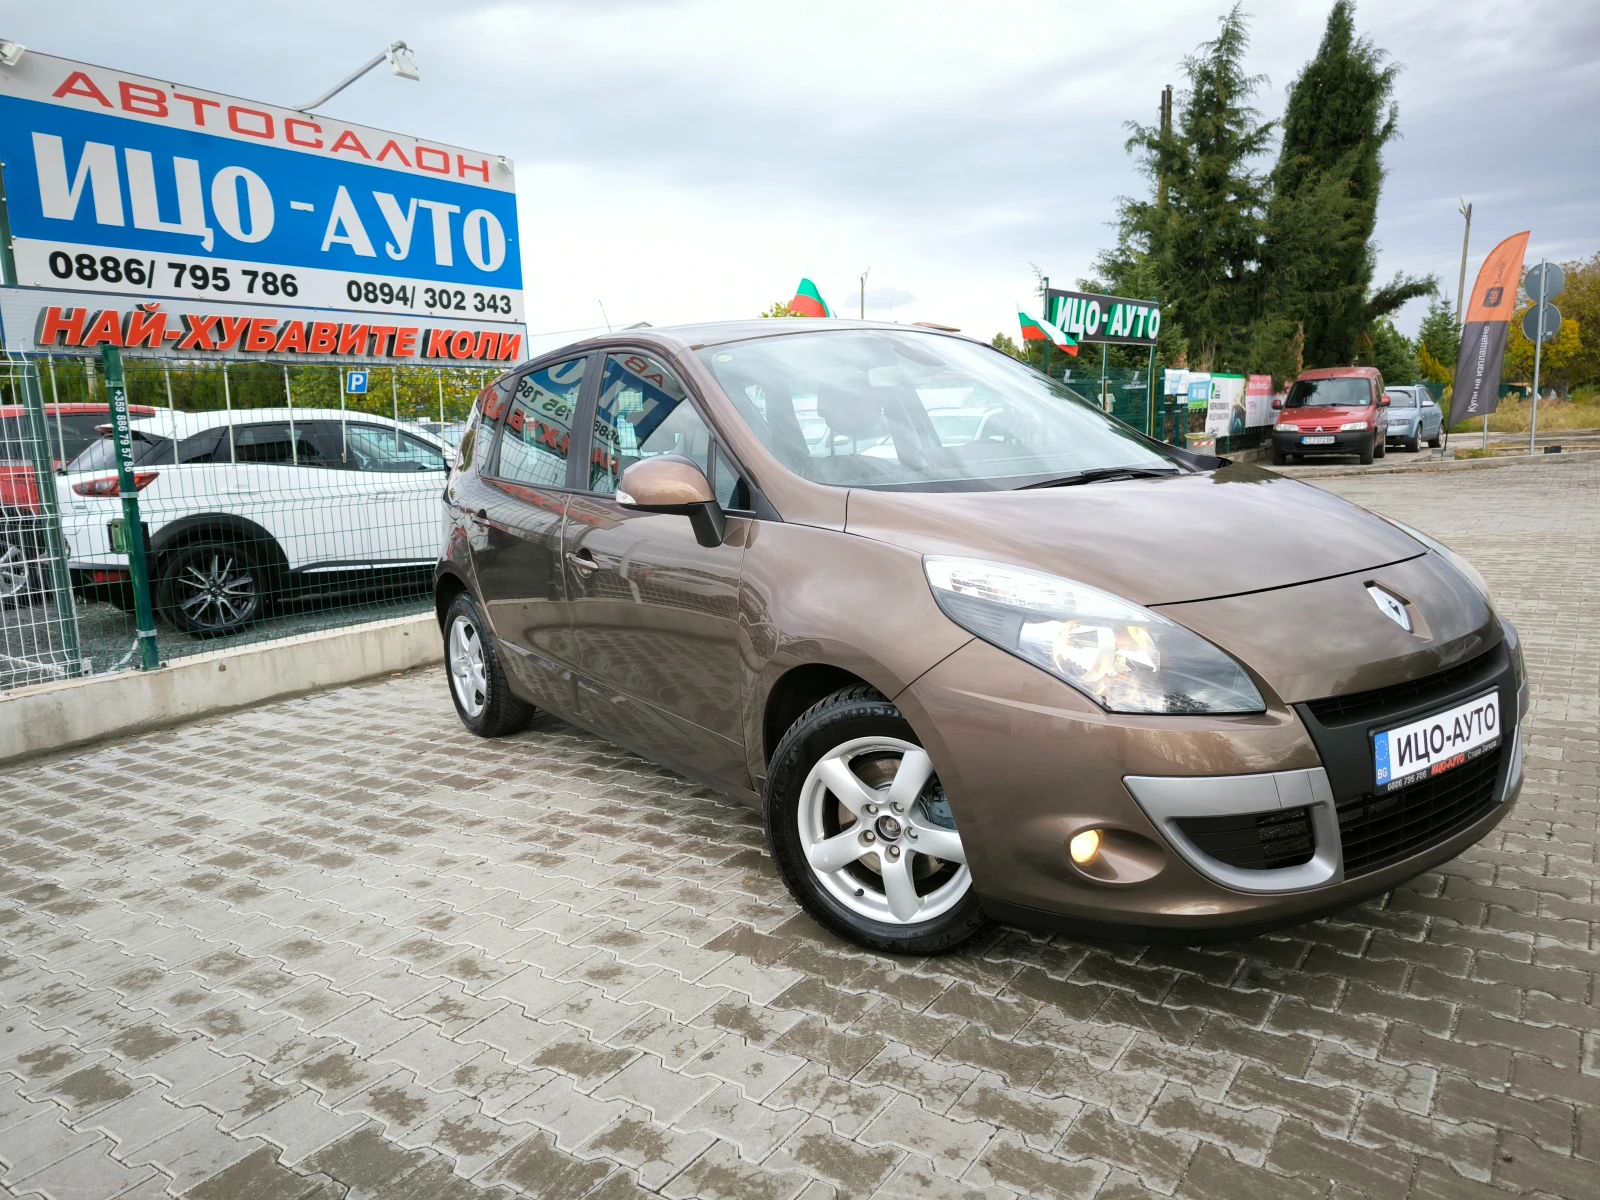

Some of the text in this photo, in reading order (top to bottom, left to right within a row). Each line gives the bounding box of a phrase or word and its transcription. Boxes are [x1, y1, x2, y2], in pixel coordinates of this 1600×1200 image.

[52, 71, 489, 183] АВТОСАЛОН
[49, 250, 298, 297] 0886/ 795 786
[346, 279, 512, 315] 0894/ 302 343
[38, 302, 522, 361] НАЙ-ХУБАВИТЕ КОЛИ
[1054, 296, 1160, 340] ИЦО-АУТО
[351, 373, 364, 391] P
[1467, 325, 1490, 413] Купи на изплащане
[114, 389, 135, 473] +359 886 79 57 86
[1397, 703, 1496, 768] ИЦО-АУТО
[1377, 767, 1388, 779] BG
[1387, 780, 1403, 791] 0886
[1404, 774, 1415, 785] 795
[1416, 770, 1427, 781] 786
